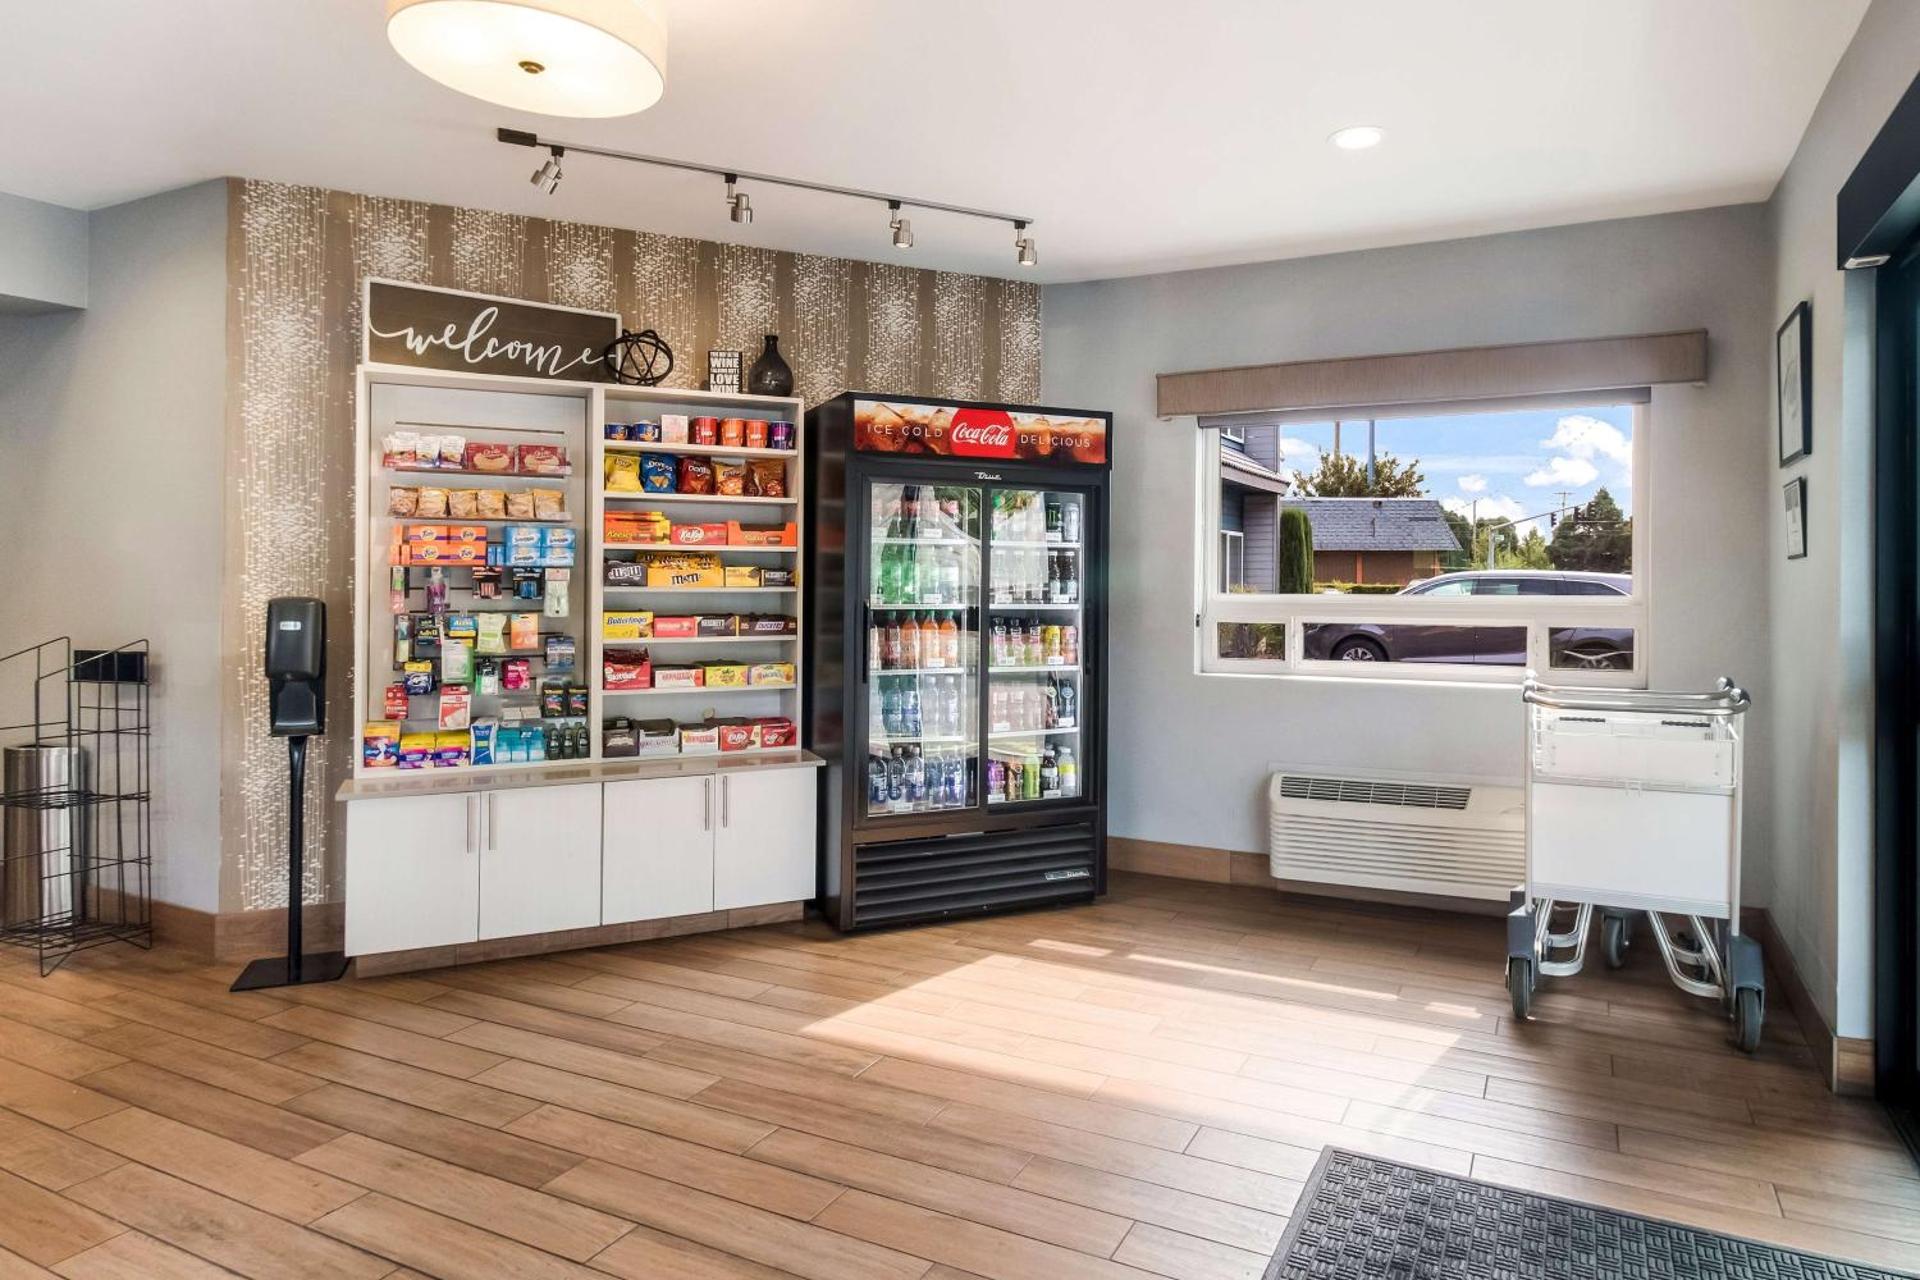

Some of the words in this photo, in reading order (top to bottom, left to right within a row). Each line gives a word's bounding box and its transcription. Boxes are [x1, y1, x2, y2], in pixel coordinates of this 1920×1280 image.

[369, 306, 616, 375] welcome
[710, 357, 739, 367] WINE
[710, 374, 739, 384] LOVE
[867, 424, 893, 435] ICE
[901, 425, 943, 437] COLD
[1020, 434, 1090, 448] DELICIOUS
